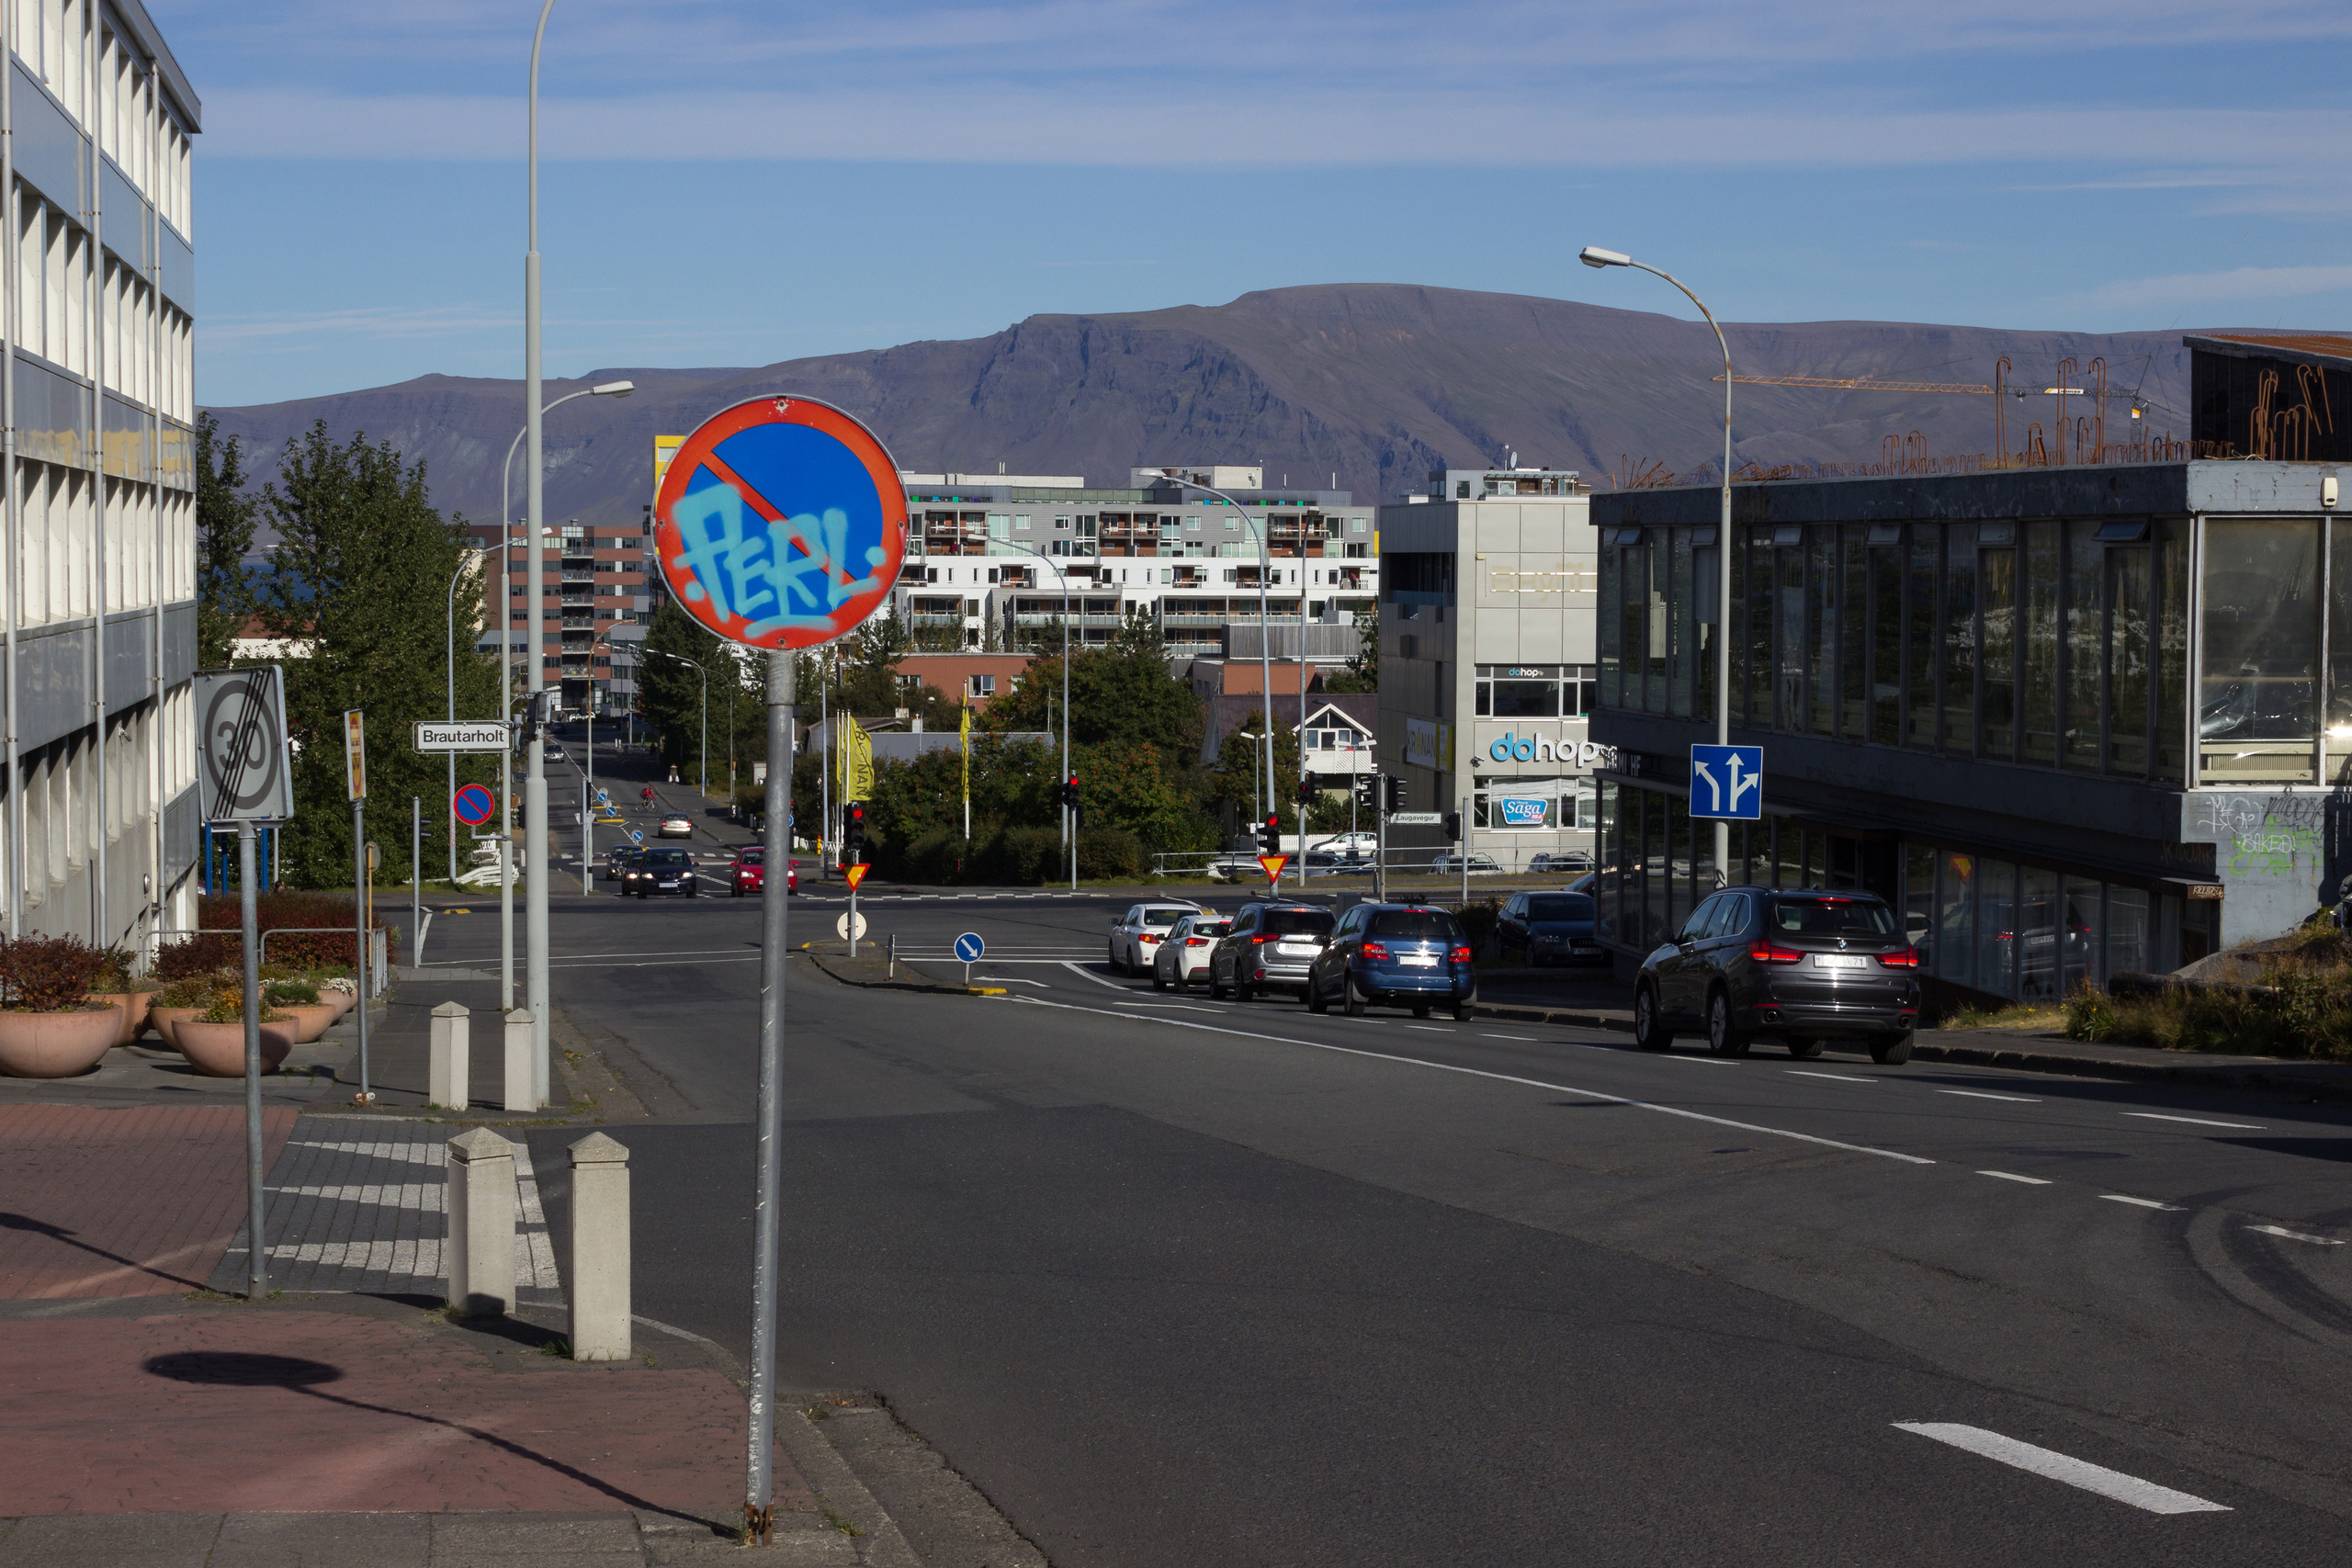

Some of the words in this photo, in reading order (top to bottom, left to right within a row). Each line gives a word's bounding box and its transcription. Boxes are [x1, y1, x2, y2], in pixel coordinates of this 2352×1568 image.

[1509, 667, 1539, 678] dohop
[424, 729, 504, 743] Brautarholt
[218, 720, 266, 770] 30
[1491, 732, 1599, 767] dohop
[1506, 801, 1541, 818] Saga
[1396, 814, 1435, 822] Laugavegur
